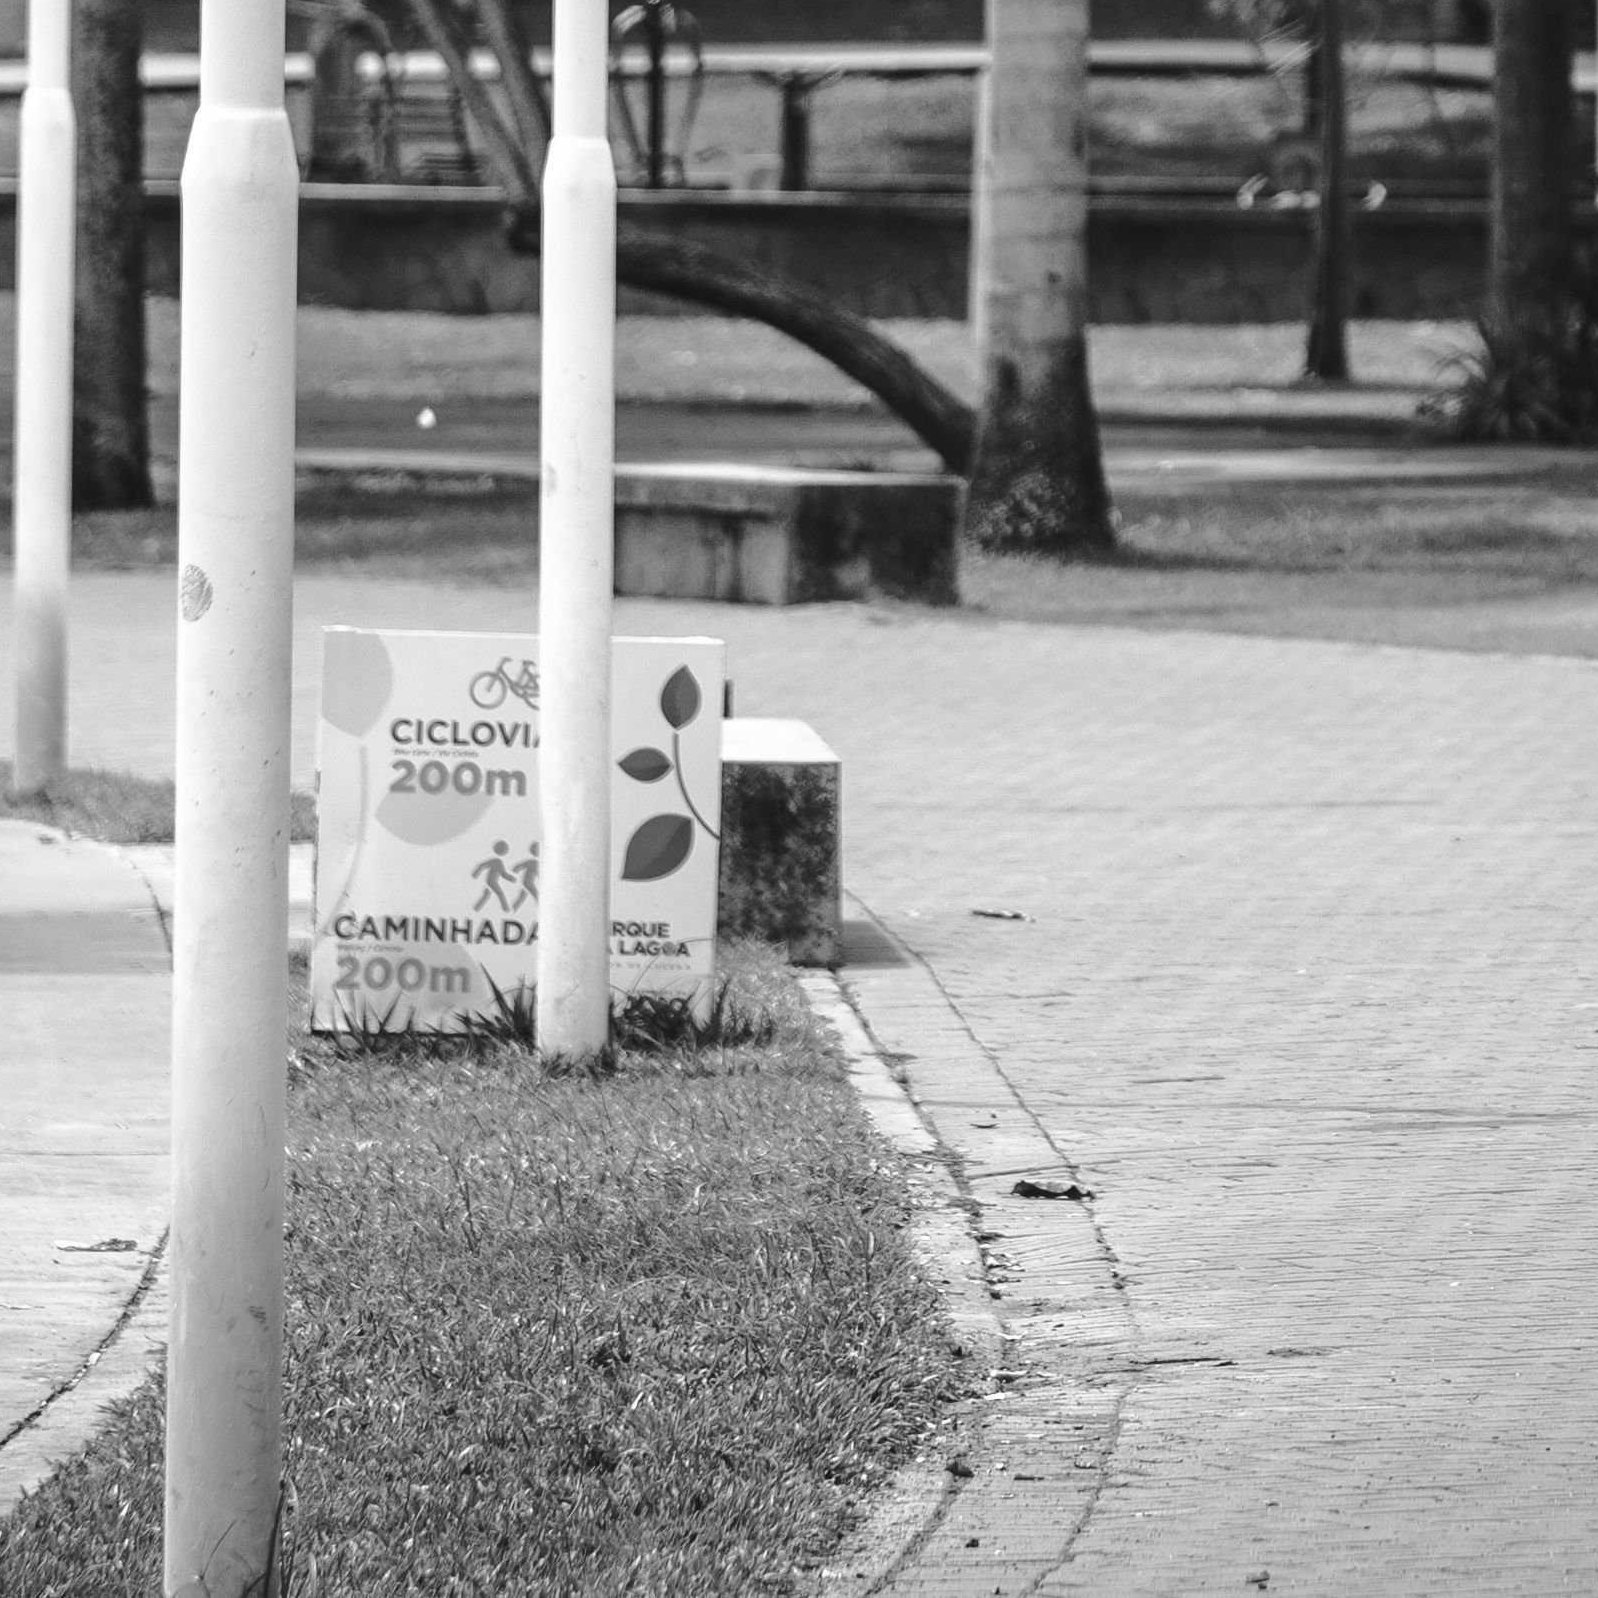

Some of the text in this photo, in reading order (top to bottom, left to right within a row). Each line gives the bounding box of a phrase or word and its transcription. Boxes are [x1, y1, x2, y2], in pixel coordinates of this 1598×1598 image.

[390, 718, 540, 748] CICLOVI
[390, 759, 527, 796] 200m
[611, 921, 670, 938] RQUE
[336, 955, 471, 993] 200m
